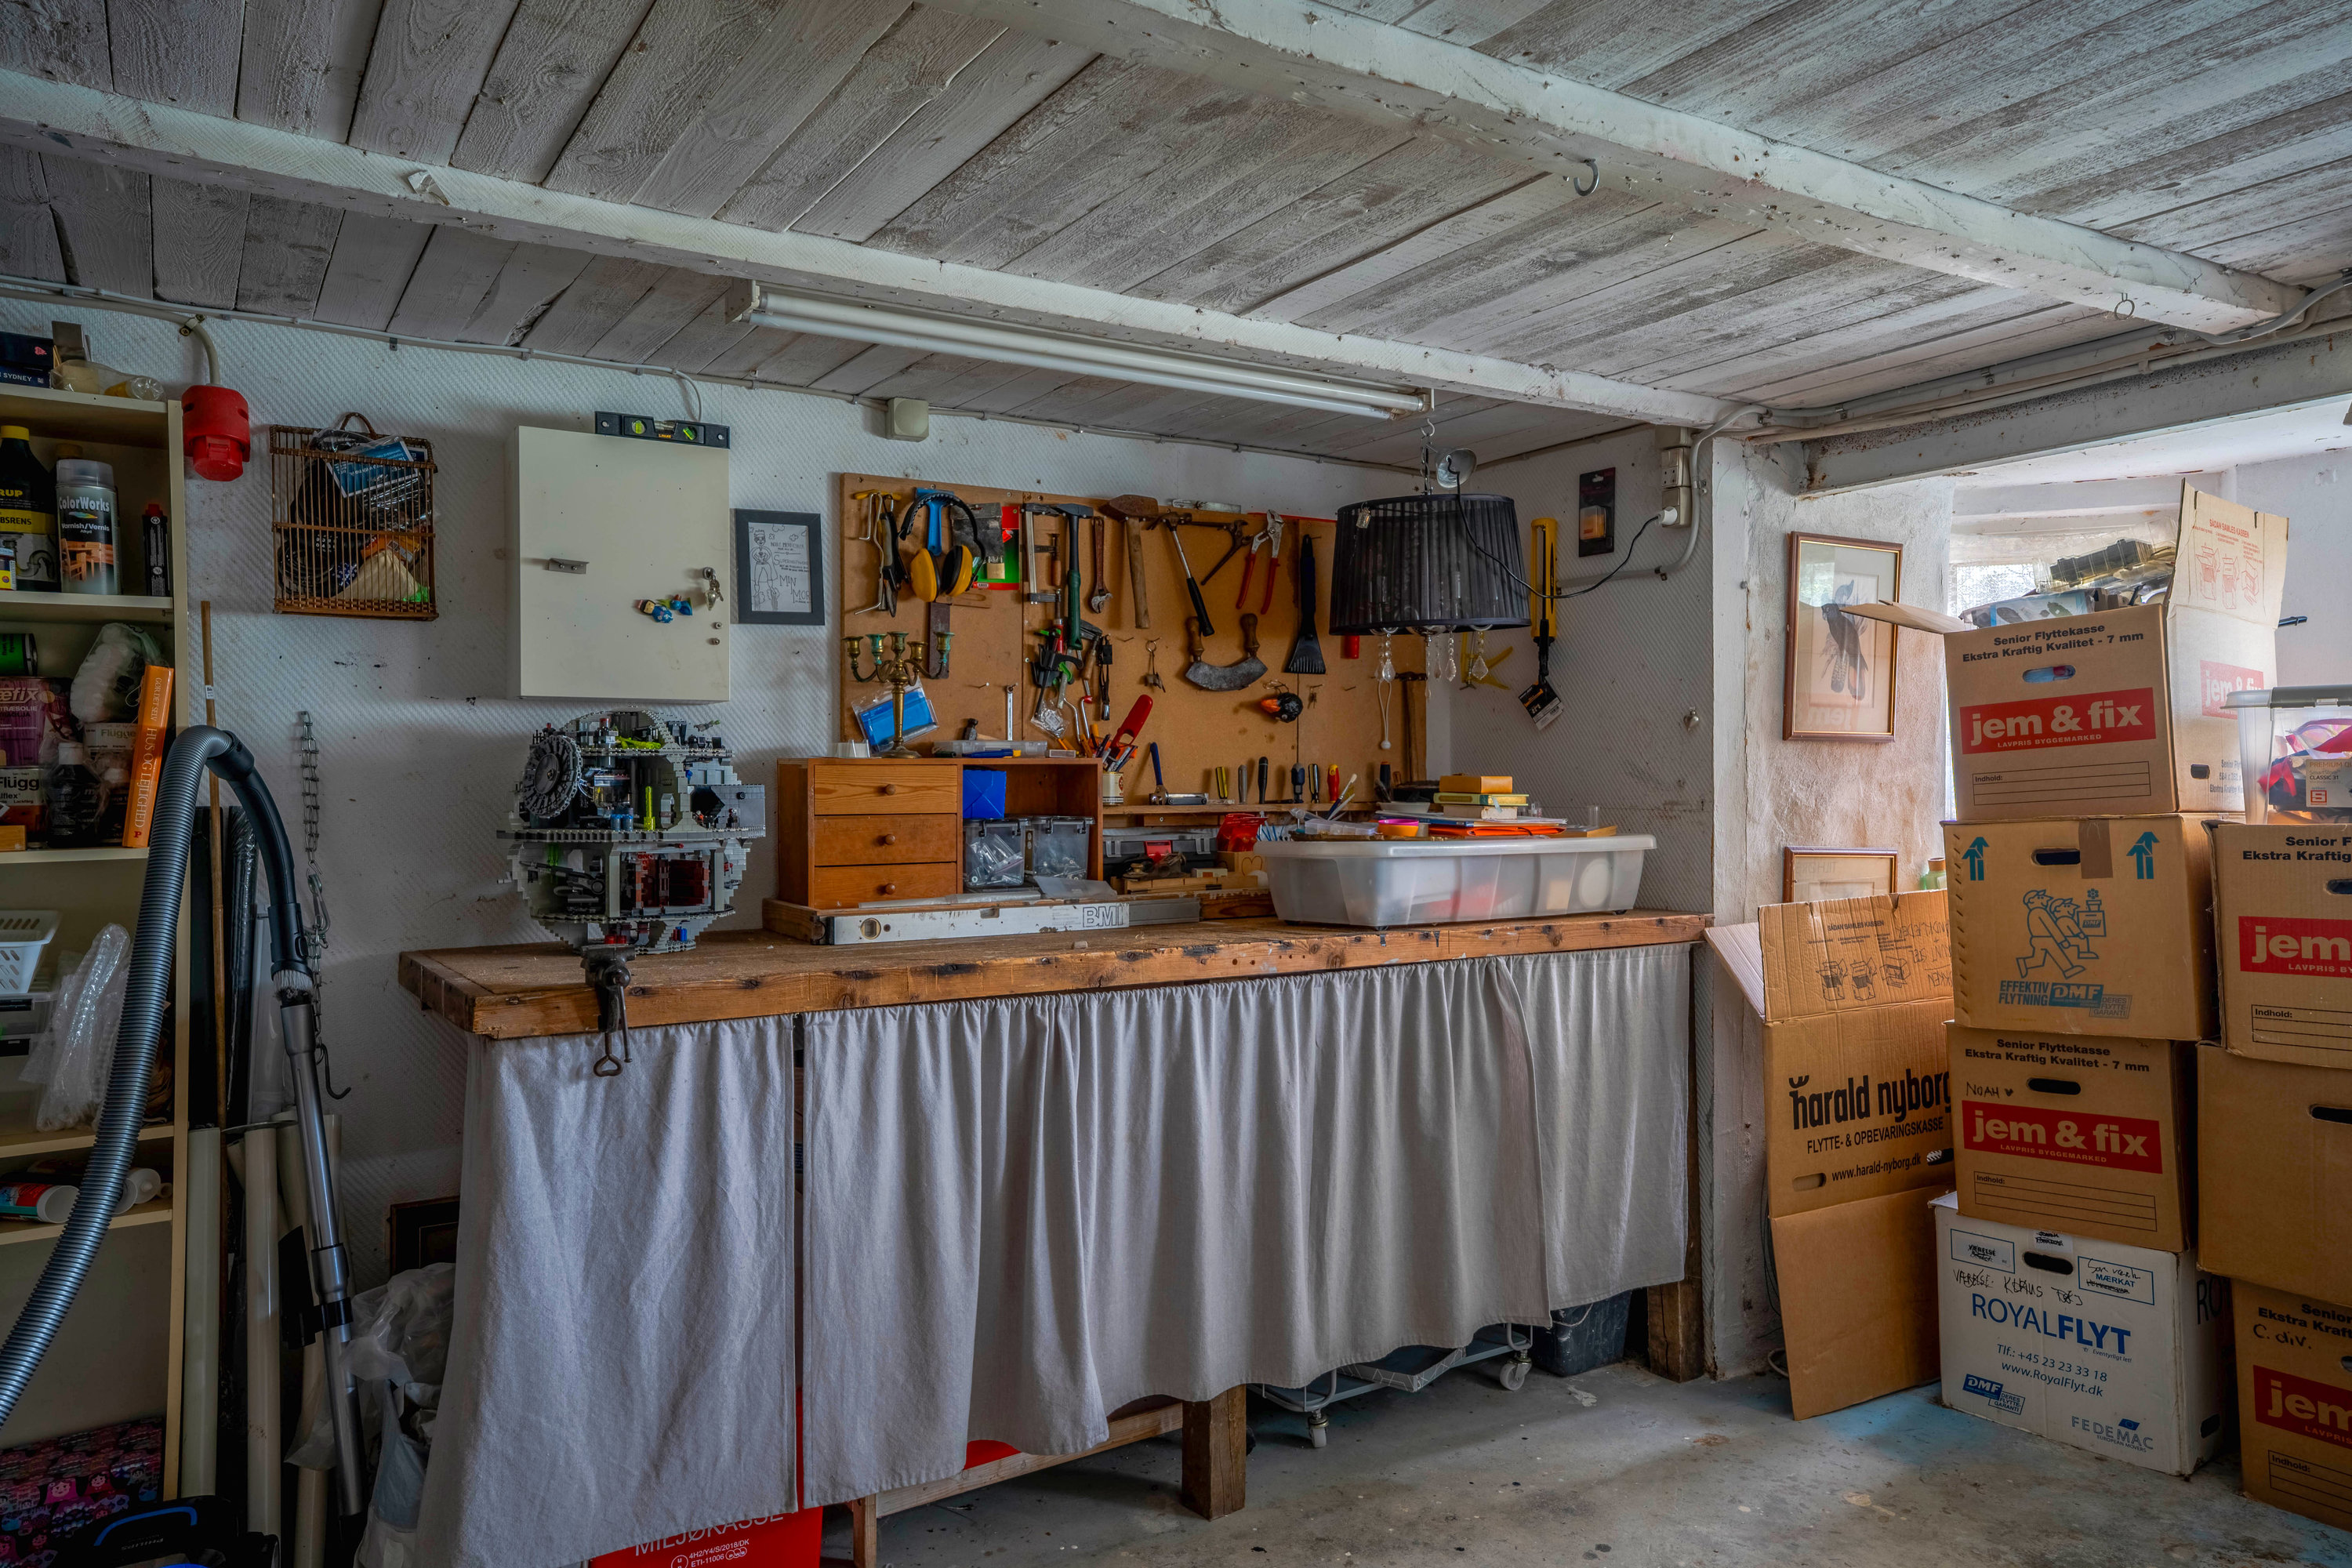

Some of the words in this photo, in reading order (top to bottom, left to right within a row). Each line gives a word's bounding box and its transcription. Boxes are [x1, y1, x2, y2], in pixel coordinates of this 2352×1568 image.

[3, 372, 33, 383] SYDNEY
[59, 495, 111, 513] ColorWorks
[61, 522, 111, 532] Varnish/Vernis
[1994, 633, 2031, 646] Senior
[2035, 623, 2105, 642] Flyttekasse
[1962, 650, 1998, 662] Ekstra
[2002, 645, 2043, 658] Kraftig
[2046, 638, 2094, 652] Kvalitet
[2108, 635, 2114, 644] 7
[2119, 632, 2144, 642] mm
[1970, 713, 2043, 746] jem
[2050, 704, 2083, 733] &
[2087, 699, 2143, 729] fix
[144, 728, 158, 751] HUS
[1998, 739, 2032, 748] LAVPRIS
[2034, 733, 2102, 746] BYGGEMARKED
[143, 753, 154, 771] OG
[1975, 774, 2003, 783] Indhold:
[134, 771, 151, 828] LEJLIGHED
[2285, 837, 2337, 847] Senior
[2242, 851, 2292, 861] Ekstra
[2296, 851, 2352, 863] Kraftig
[2252, 925, 2352, 964] jem
[2288, 964, 2336, 973] LAVPRIS
[2000, 980, 2050, 993] EFFEKTIV
[2052, 985, 2100, 1000] DMF
[1999, 993, 2049, 1006] FLYTNING
[2255, 1008, 2292, 1018] Indhold:
[1997, 1039, 2035, 1051] Senior
[2038, 1042, 2111, 1056] Flyttekasse
[1965, 1048, 2002, 1061] Ekstra
[2005, 1052, 2046, 1065] Kraftig
[2050, 1056, 2100, 1068] Kvalitet
[2112, 1061, 2120, 1070] 7
[2125, 1063, 2150, 1072] mm
[1965, 1081, 2000, 1098] NOAH
[1788, 1075, 1871, 1130] harald
[1807, 1134, 1844, 1154] FLYTTE-
[1846, 1134, 1852, 1147] &
[1854, 1116, 1944, 1145] OPBEVARINGSKASSE
[1973, 1109, 2047, 1145] jem
[2054, 1120, 2088, 1150] &
[2092, 1123, 2149, 1158] fix
[2000, 1144, 2035, 1154] LAVPRIS
[2038, 1148, 2107, 1163] BYGGEMARKED
[1831, 1152, 1922, 1181] www.harald-nyborg.dk
[1976, 1174, 2005, 1185] Indhold:
[2095, 1273, 2136, 1287] MÆRKAT
[2259, 1306, 2307, 1328] Ekstra
[2302, 1303, 2352, 1323] Senior
[1972, 1293, 2131, 1355] ROYALFLYT
[1997, 1344, 2015, 1357] Tlf.:
[2018, 1352, 2039, 1364] +45
[2042, 1356, 2055, 1368] 23
[2058, 1361, 2072, 1372] 23
[2074, 1366, 2089, 1377] 33
[2094, 1370, 2107, 1381] 18
[2092, 1348, 2122, 1363] Eventyrligt
[1967, 1377, 2002, 1393] DMF
[2002, 1362, 2103, 1397] www.RoyalFlyt.dk
[1994, 1401, 2020, 1412] GARANTI
[2001, 1392, 2020, 1403] DERES
[2267, 1379, 2352, 1431] jem
[2071, 1416, 2154, 1450] FEDEMAC
[2305, 1425, 2352, 1444] LAVPRIS
[2096, 1435, 2125, 1446] EUROPEAN
[2125, 1443, 2147, 1453] MOVERS
[2272, 1454, 2311, 1472] Indhold:
[688, 1538, 750, 1559] 4H2/Y4/S/2018/DK
[691, 1553, 724, 1568] ETI-11006
